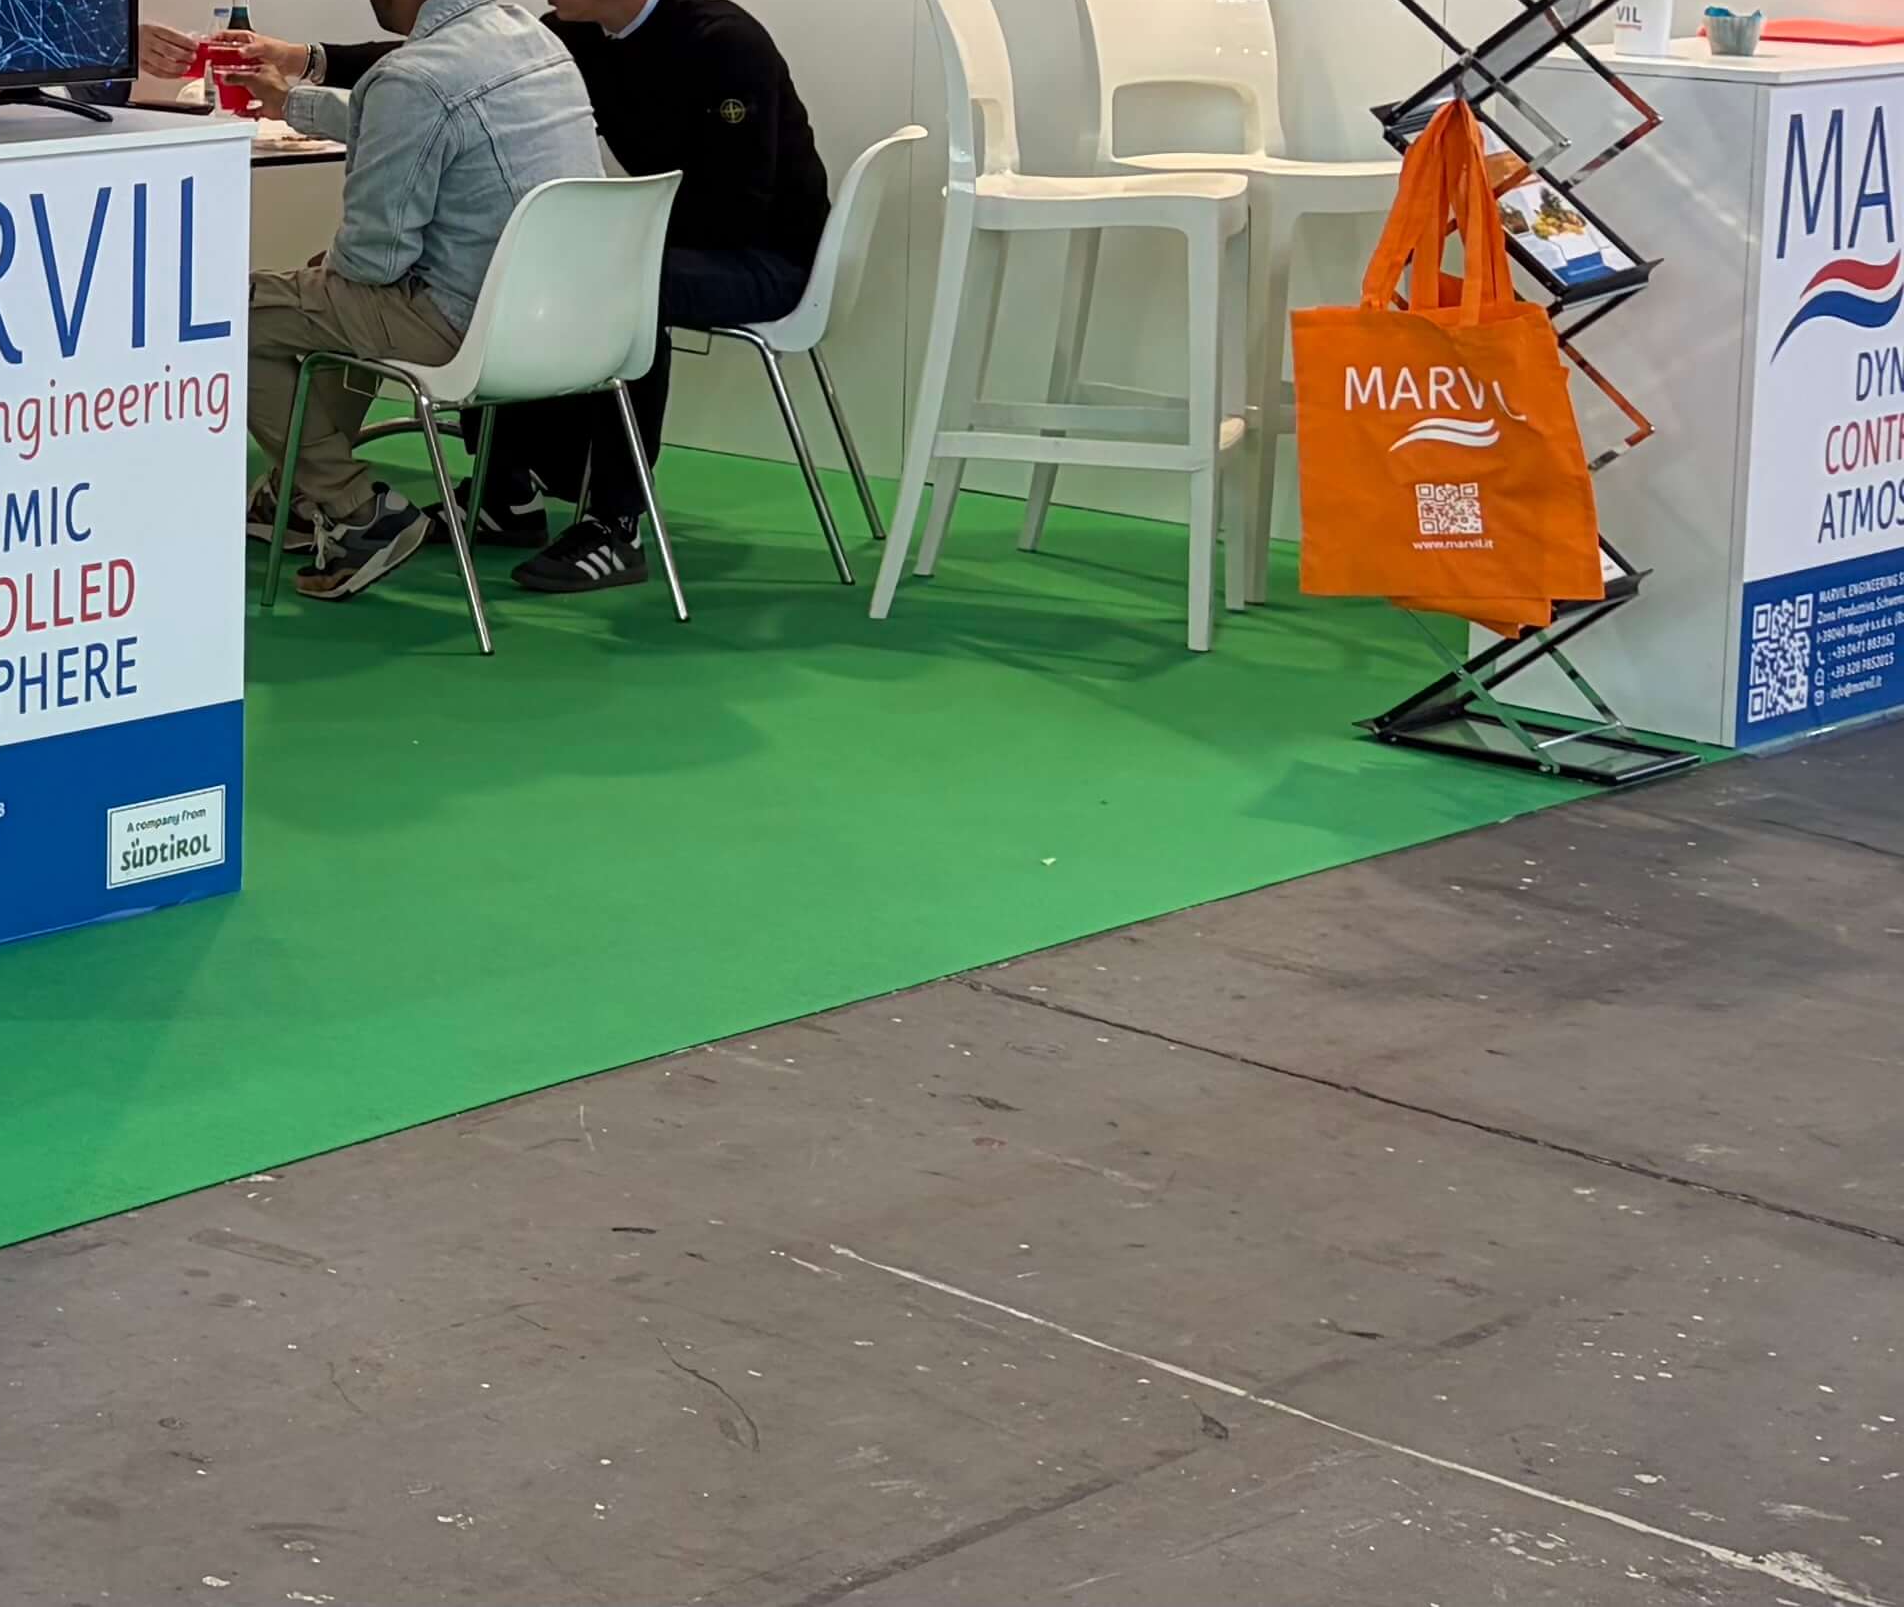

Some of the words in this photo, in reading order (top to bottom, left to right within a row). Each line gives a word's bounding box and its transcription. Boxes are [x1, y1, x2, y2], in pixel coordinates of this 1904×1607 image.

[1776, 105, 1895, 259] MA
[127, 822, 134, 832] A
[136, 814, 179, 830] company
[182, 808, 206, 820] from
